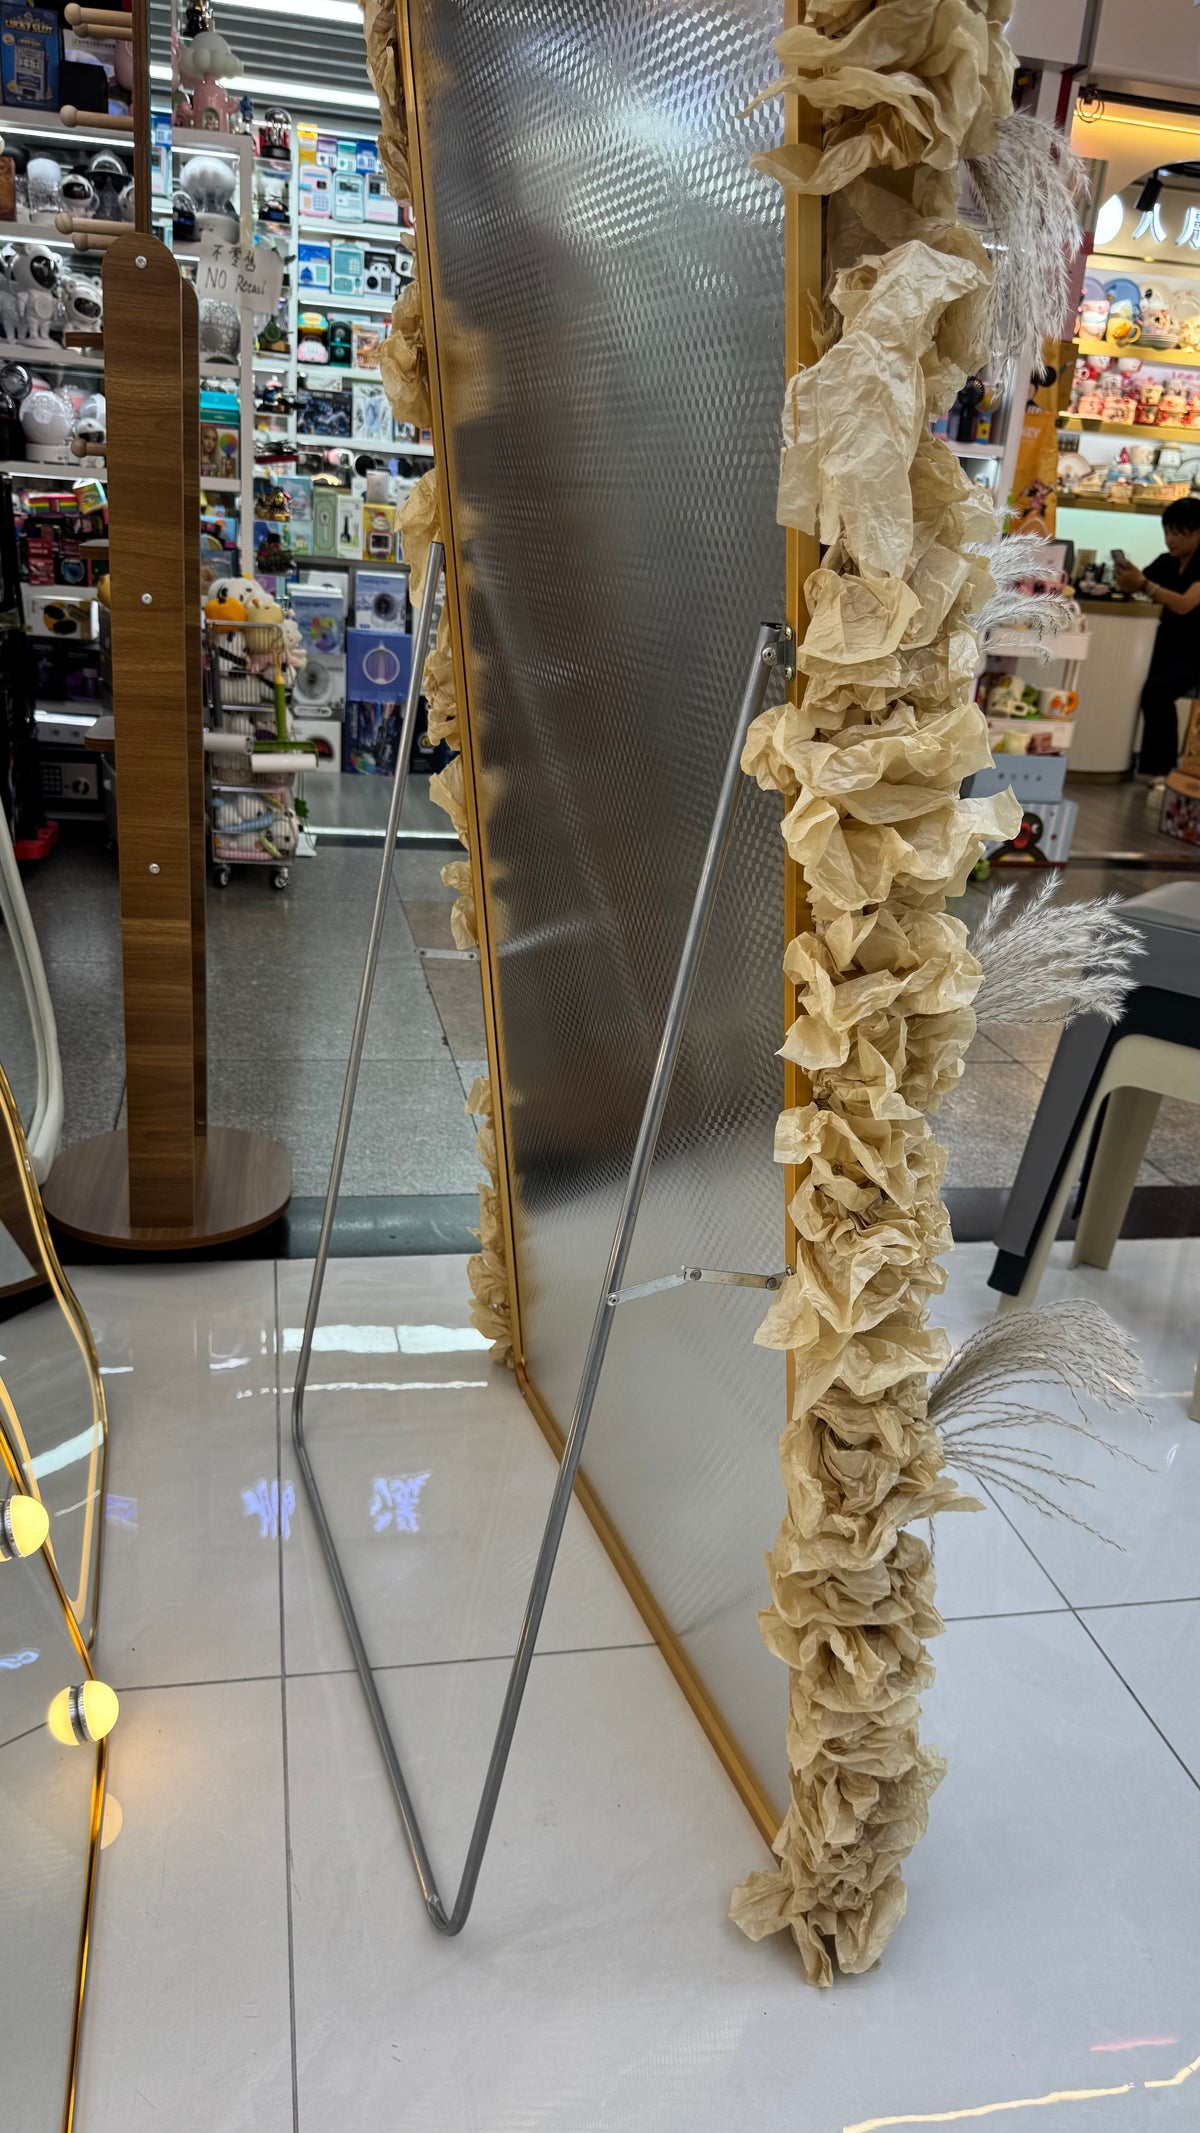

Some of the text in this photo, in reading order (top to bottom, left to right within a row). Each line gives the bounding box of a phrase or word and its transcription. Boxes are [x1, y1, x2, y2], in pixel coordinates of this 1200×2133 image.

[5, 18, 53, 34] LUCKY SLOT
[212, 244, 256, 272] 不零售
[205, 266, 267, 295] NO Retail
